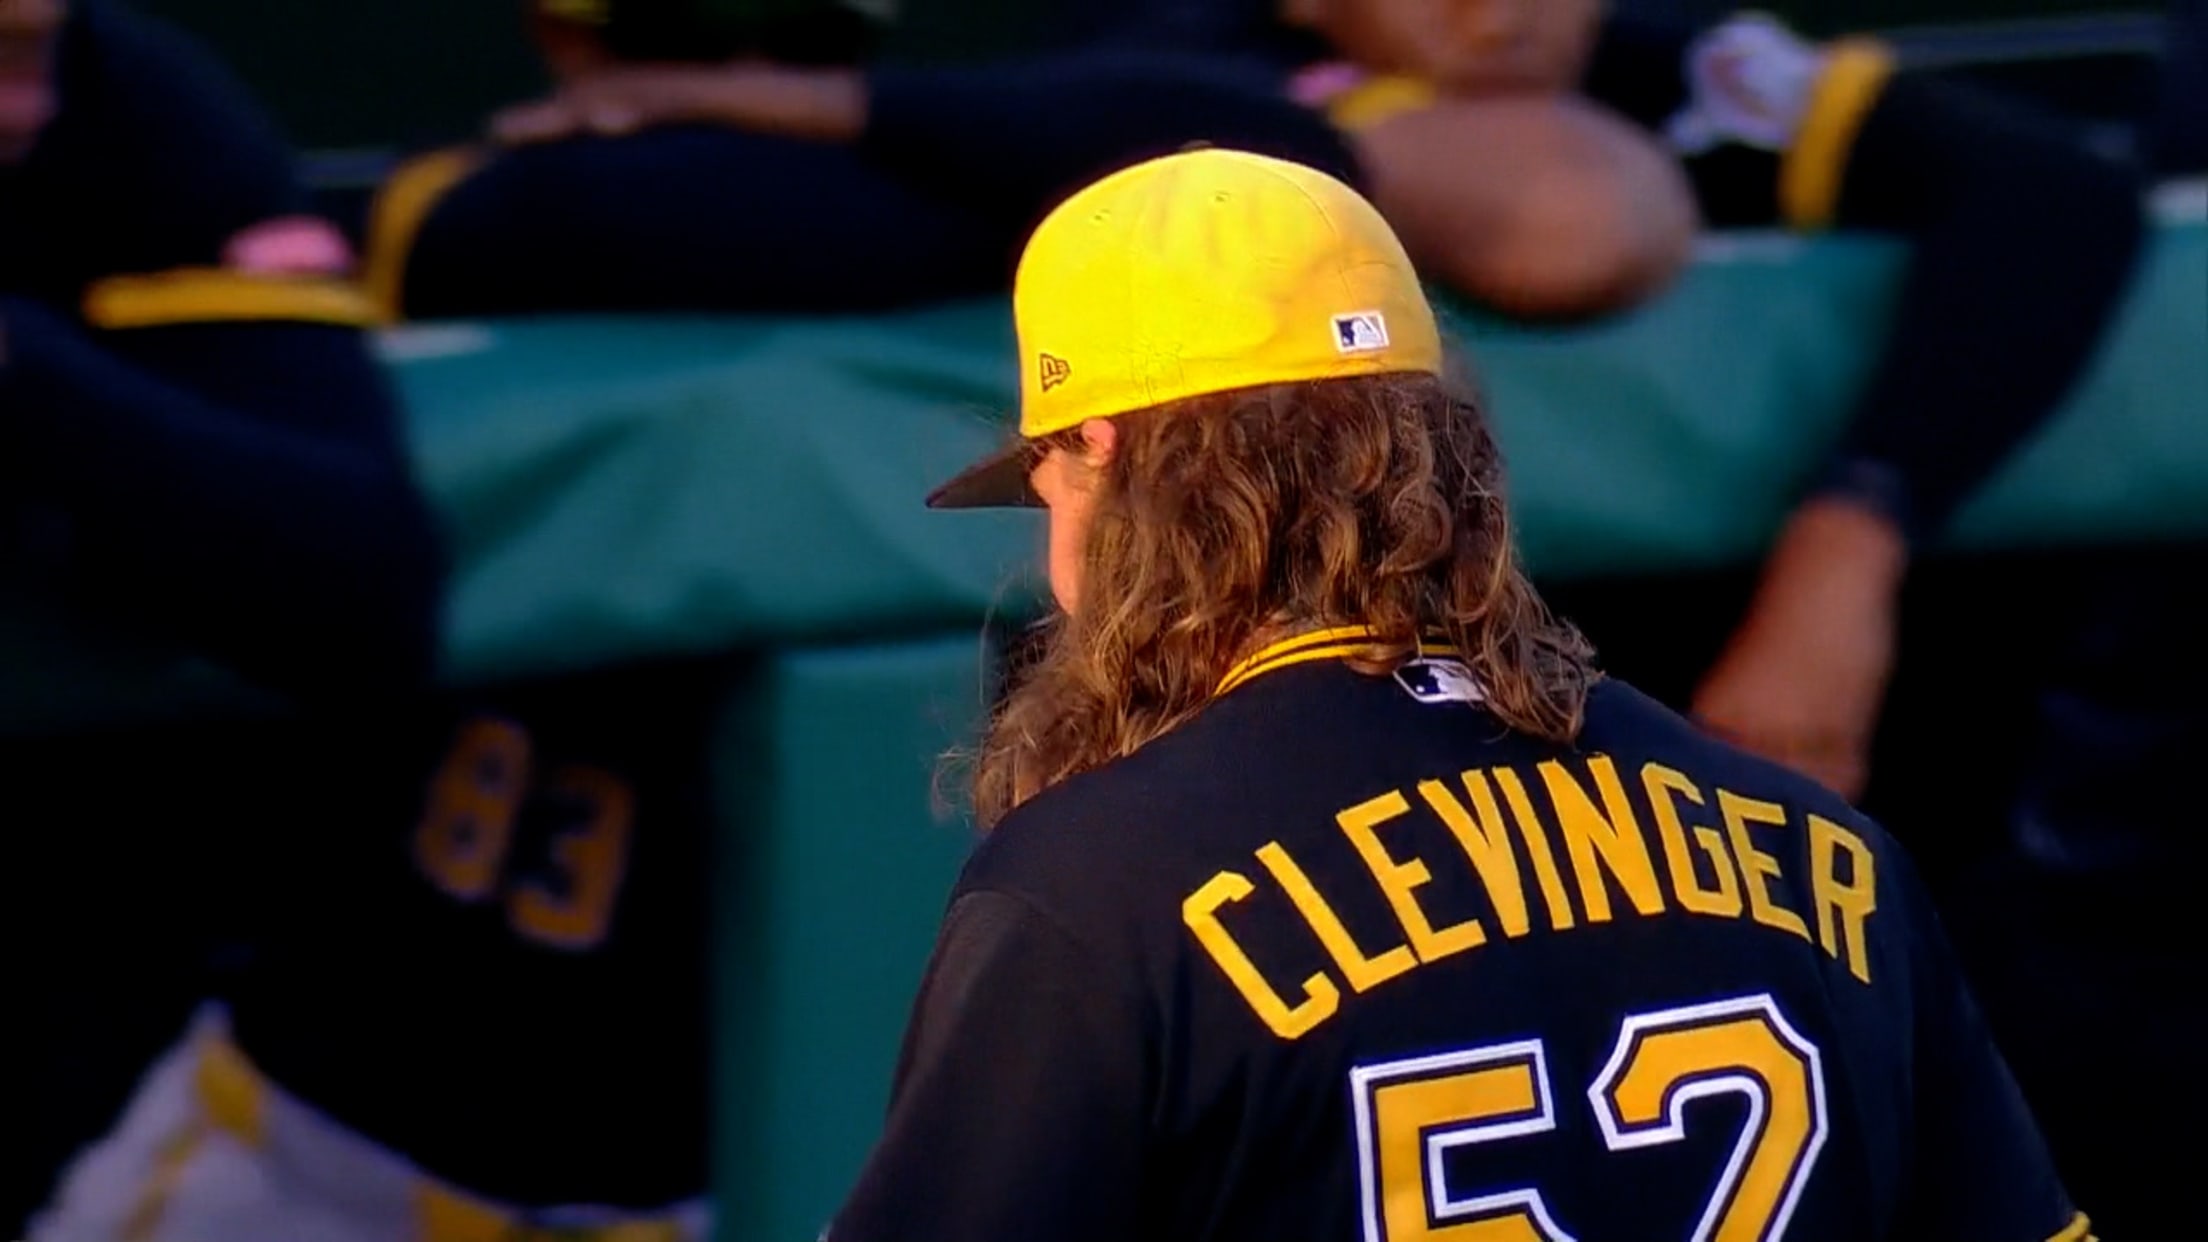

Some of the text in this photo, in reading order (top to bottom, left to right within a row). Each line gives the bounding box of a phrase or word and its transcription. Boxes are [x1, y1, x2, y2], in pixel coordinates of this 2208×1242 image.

[415, 717, 636, 946] 83
[1182, 752, 1876, 1040] CLEVINGER
[1350, 993, 1828, 1242] 52
